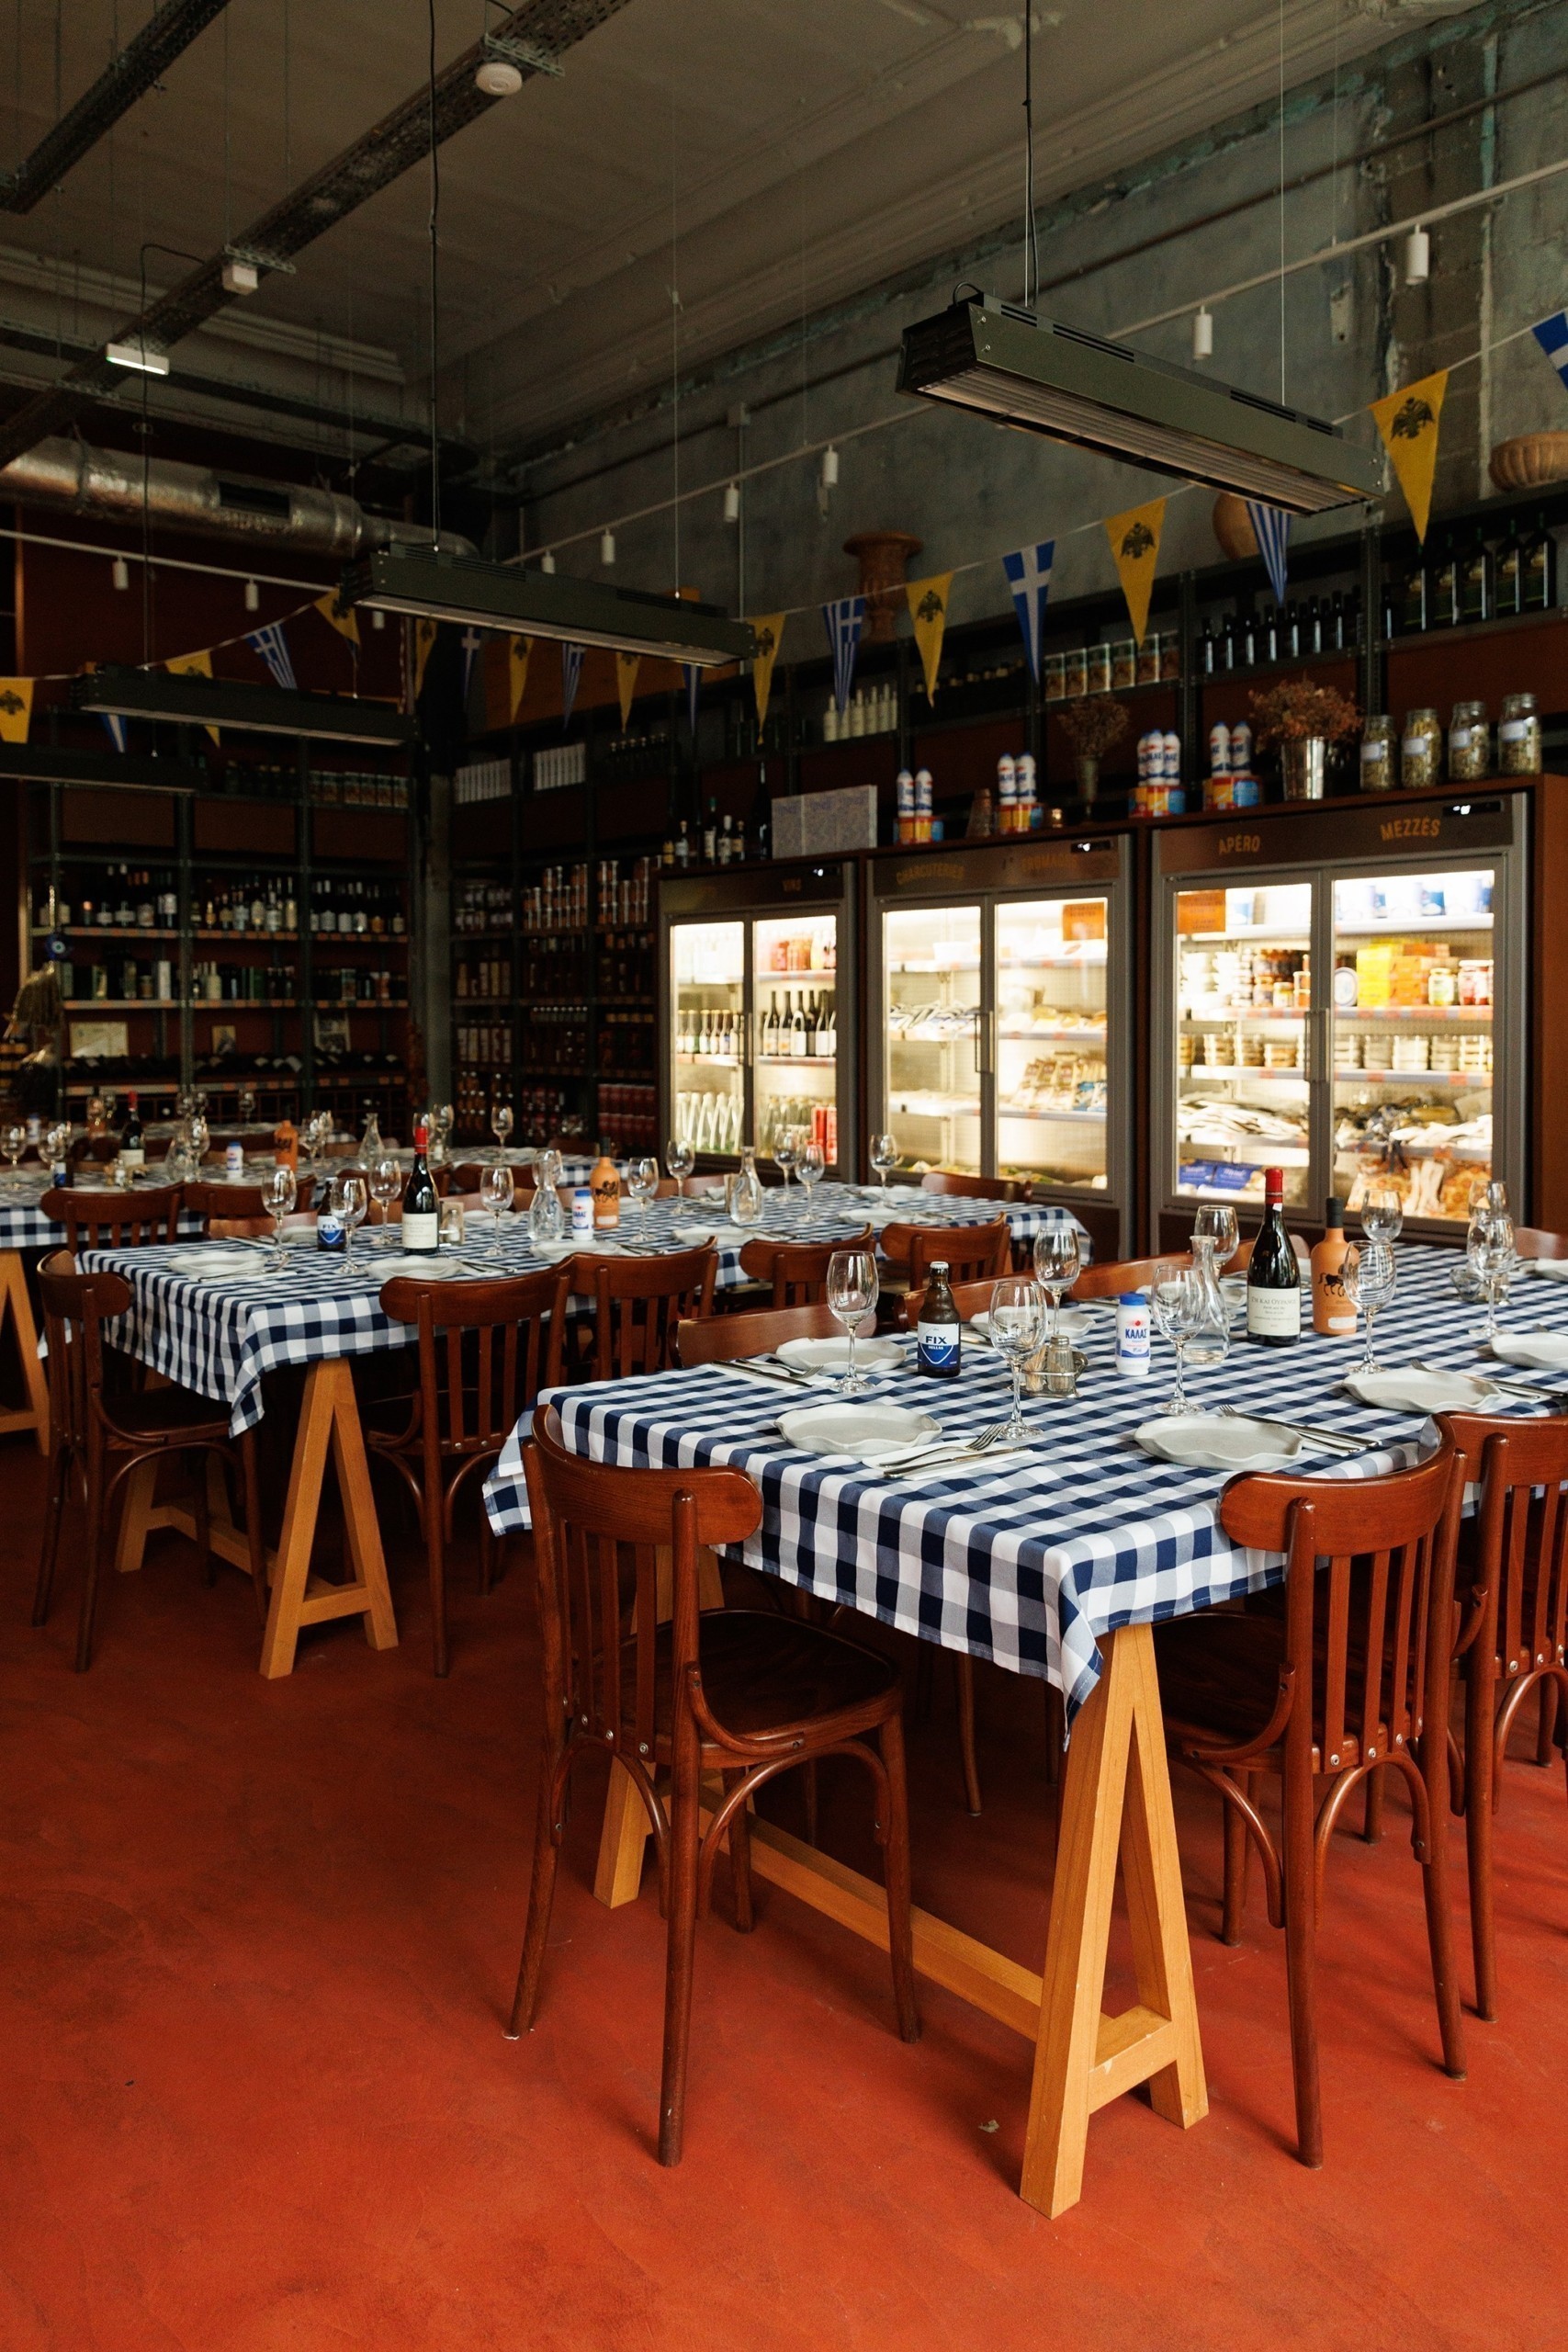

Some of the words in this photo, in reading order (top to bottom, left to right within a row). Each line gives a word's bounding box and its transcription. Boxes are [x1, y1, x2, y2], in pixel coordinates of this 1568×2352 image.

[1381, 816, 1441, 841] MEZZÉS
[1218, 834, 1261, 855] APÉRO
[925, 1335, 947, 1344] FIX
[1125, 1328, 1147, 1339] ΚΑΛΑΣ
